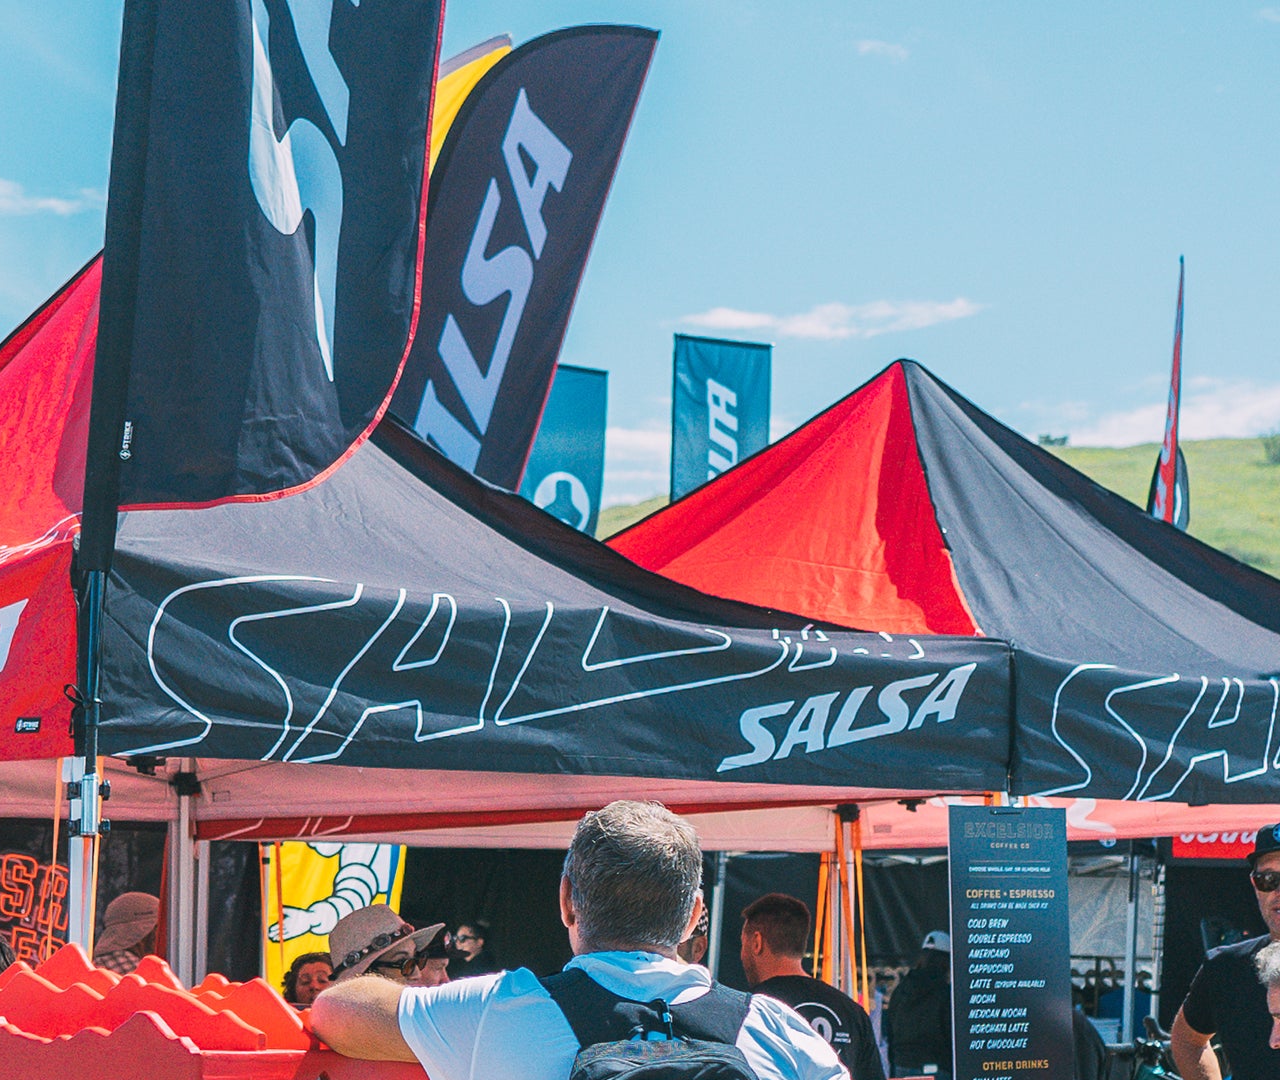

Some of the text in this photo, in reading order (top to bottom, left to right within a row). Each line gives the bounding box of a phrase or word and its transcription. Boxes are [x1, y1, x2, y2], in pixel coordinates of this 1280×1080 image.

[717, 663, 978, 773] SALSA
[963, 821, 1055, 839] EXCELSIOR
[966, 889, 1055, 899] COFFEE ESPRESSO
[967, 918, 1009, 929] COLD BREW
[967, 933, 1033, 944] DOUBLE ESPRESSO
[968, 948, 1010, 958] AMERICANO
[968, 963, 1014, 974] CAPPUCCINO
[969, 979, 992, 989] LATTE
[969, 993, 996, 1004] MOCHA
[968, 1007, 1028, 1019] MEXICAN MOCHA
[969, 1022, 1030, 1034] HORCHATA LATTE
[969, 1038, 1028, 1050] HOT CHOCOLATE
[982, 1060, 1049, 1071] OTHER DRINKS
